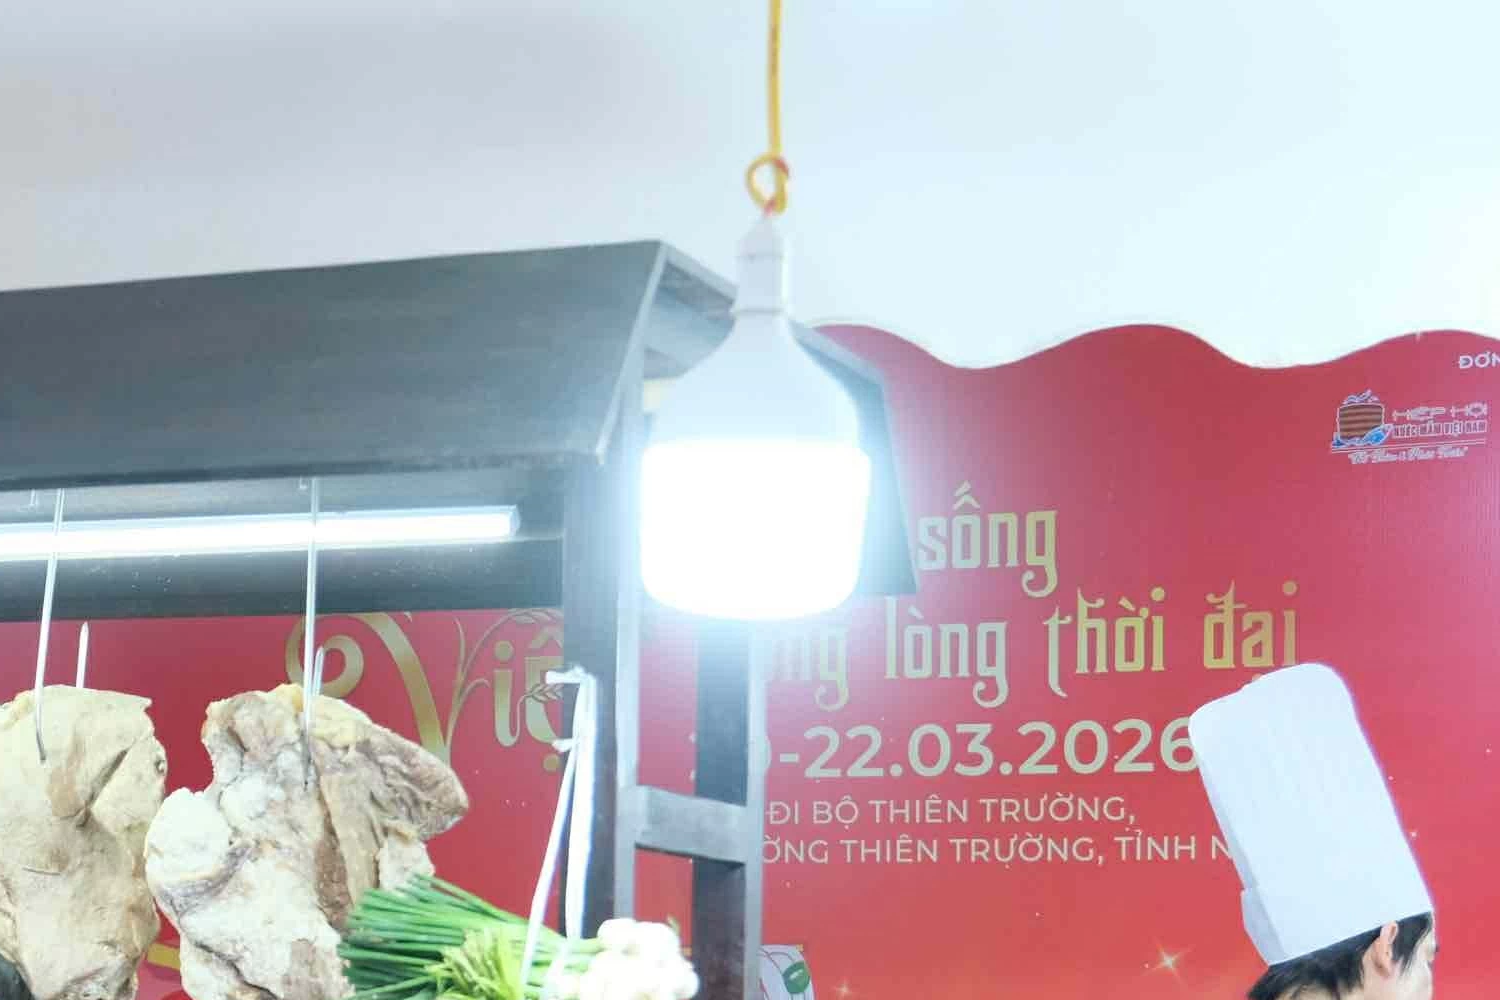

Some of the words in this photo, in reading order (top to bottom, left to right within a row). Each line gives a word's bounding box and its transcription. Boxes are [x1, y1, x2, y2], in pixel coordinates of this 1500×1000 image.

[917, 480, 1060, 598] sống
[884, 596, 1010, 709] lòng
[1043, 586, 1167, 698] thời
[765, 800, 800, 825] ĐI
[812, 795, 860, 831] BỘ
[868, 794, 968, 824] THIÊN
[979, 791, 1137, 825] TRƯỜNG,
[840, 833, 938, 864] THIÊN
